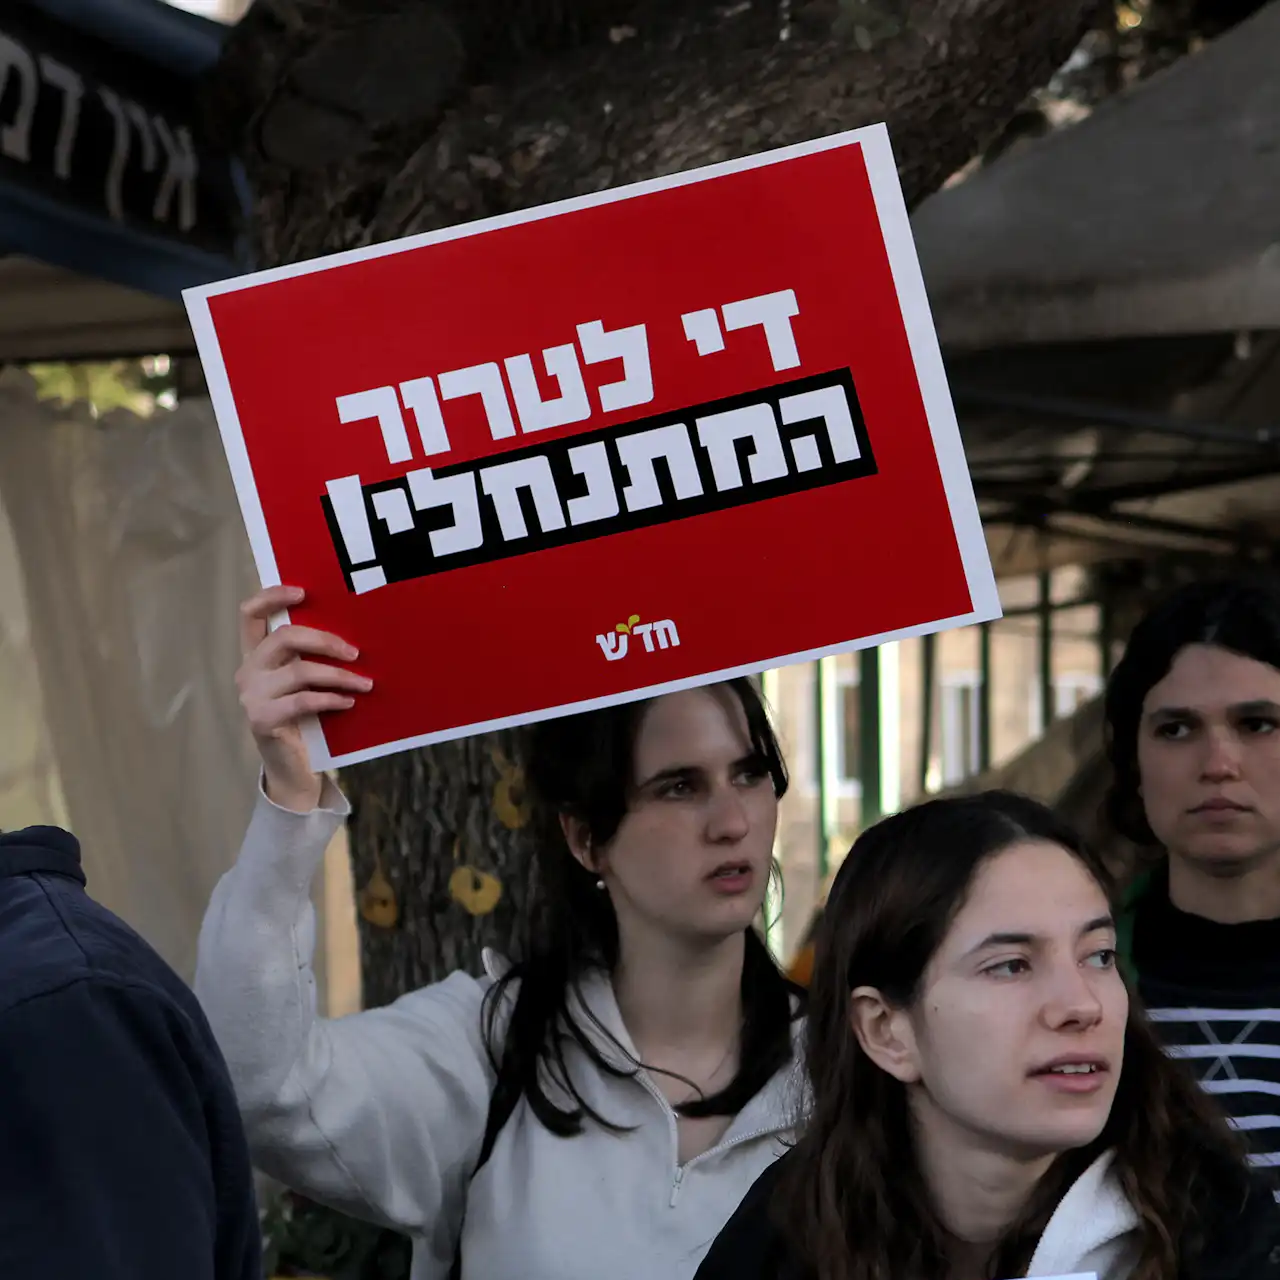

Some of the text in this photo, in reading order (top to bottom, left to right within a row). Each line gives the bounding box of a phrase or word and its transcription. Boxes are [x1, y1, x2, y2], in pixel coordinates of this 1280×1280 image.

[336, 288, 801, 464] די לטרור
[325, 385, 861, 595] המתנחלי!
